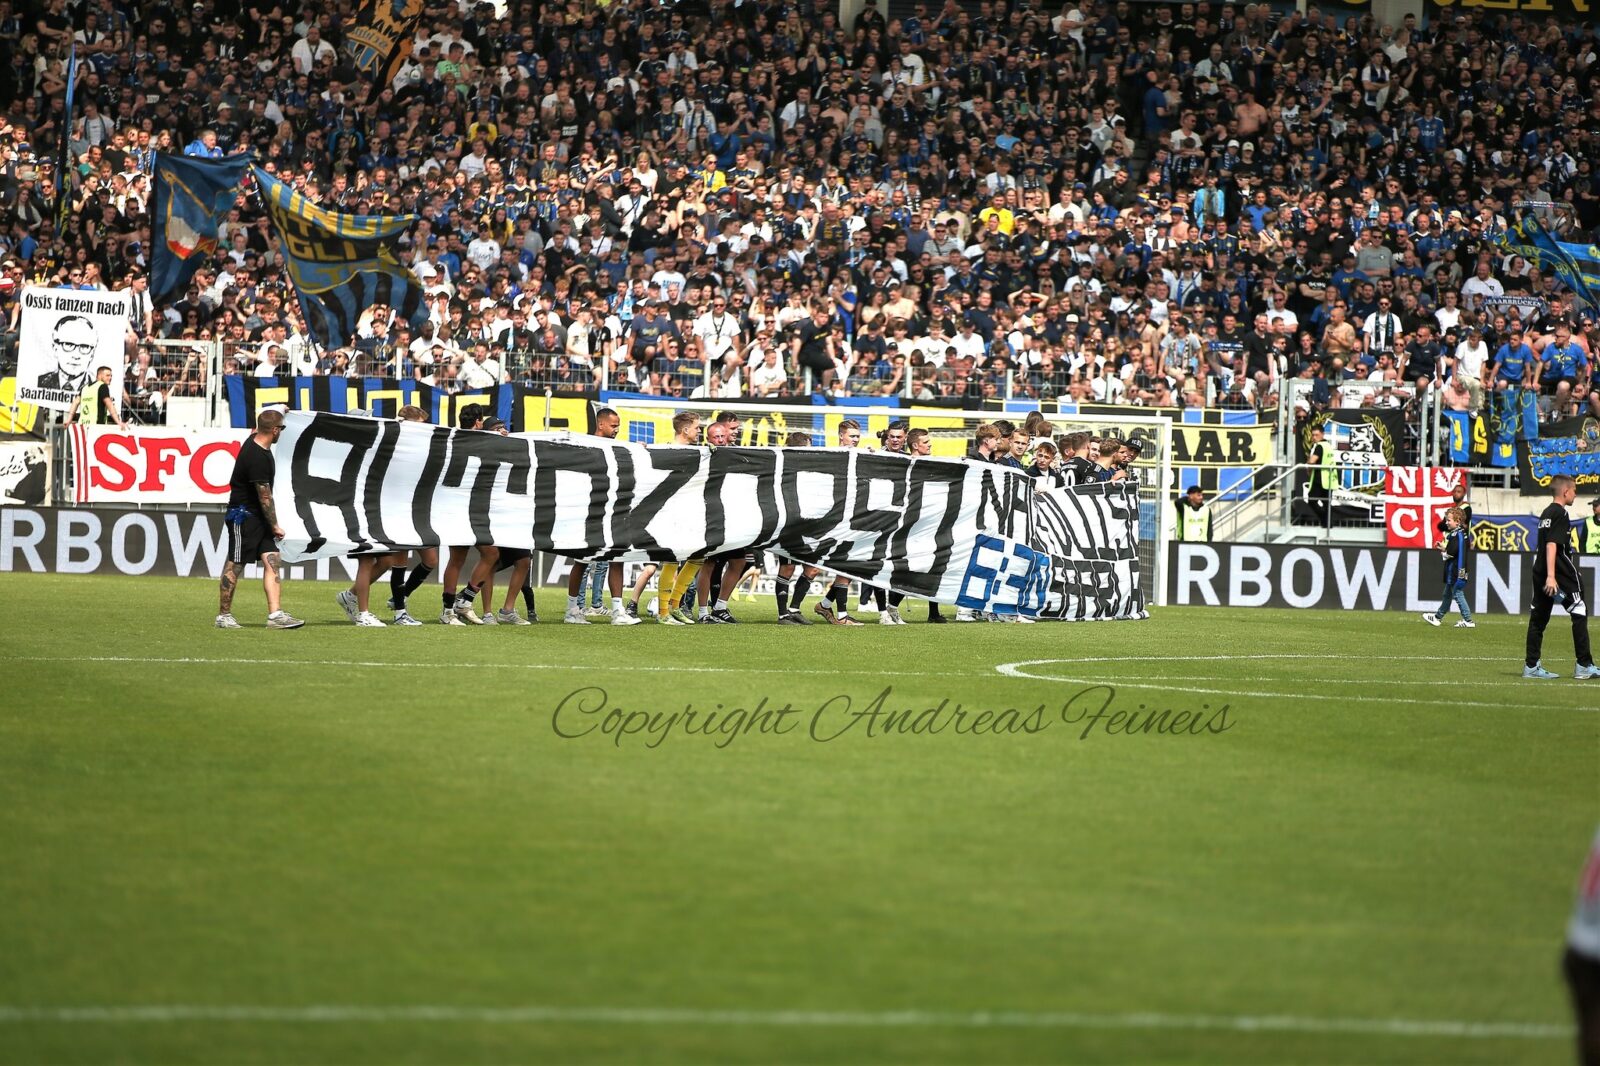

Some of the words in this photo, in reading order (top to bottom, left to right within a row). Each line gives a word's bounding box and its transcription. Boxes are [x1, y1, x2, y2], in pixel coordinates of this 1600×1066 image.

[25, 293, 52, 310] Ossis
[55, 296, 94, 314] tanzen
[97, 301, 125, 316] nach
[90, 434, 241, 495] SFC
